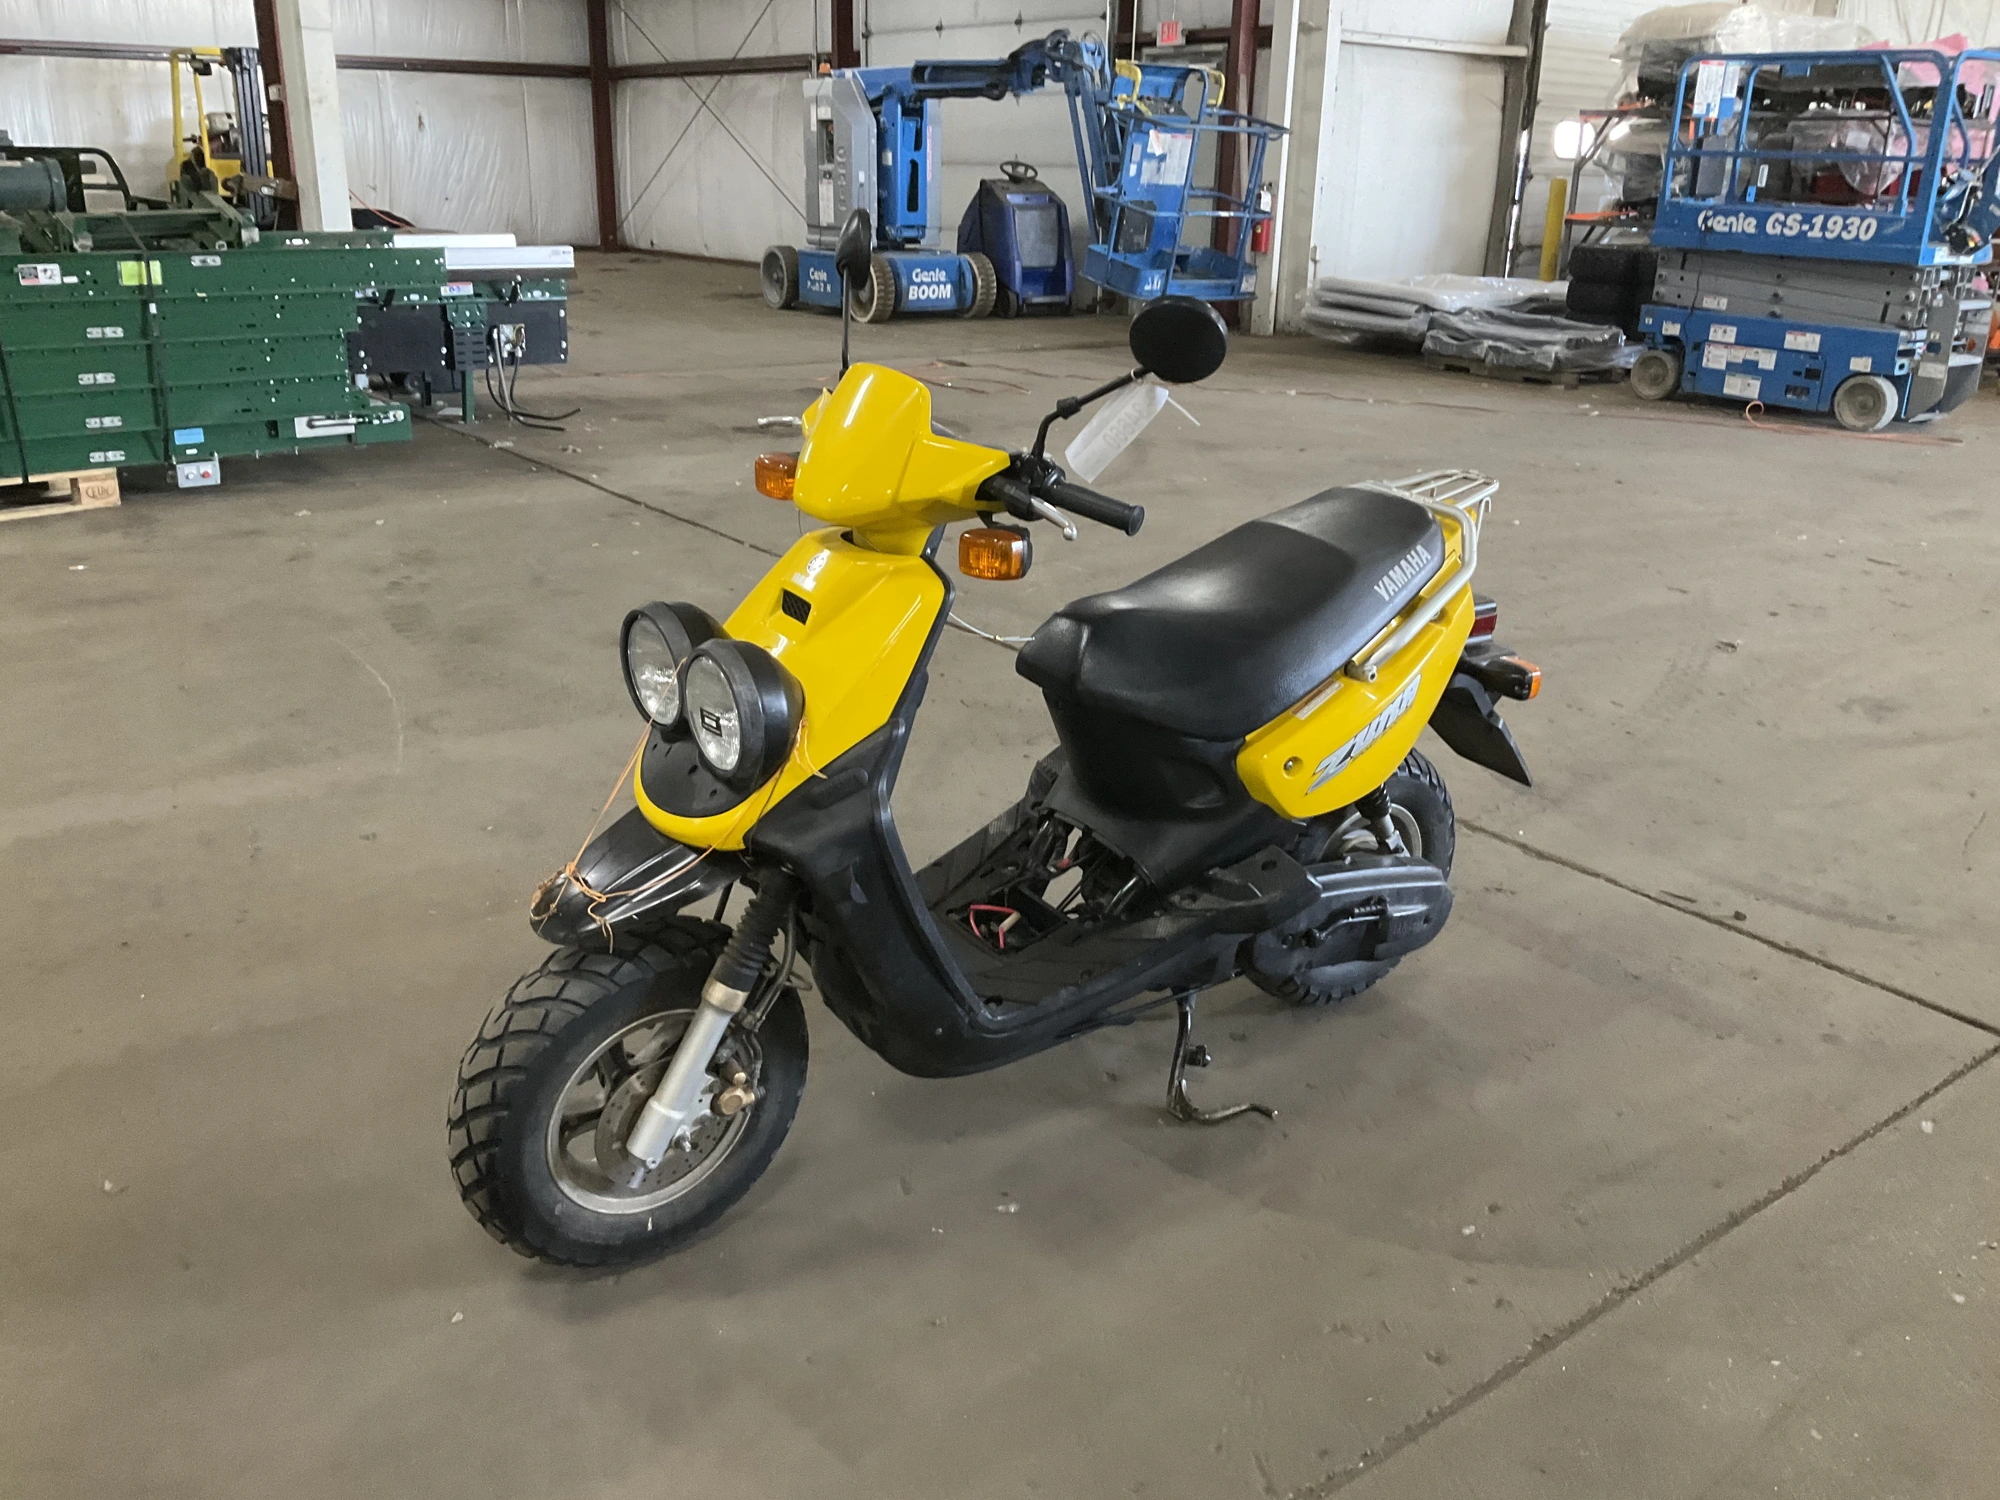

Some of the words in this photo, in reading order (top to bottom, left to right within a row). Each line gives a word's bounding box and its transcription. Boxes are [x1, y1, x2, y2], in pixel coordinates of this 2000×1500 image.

[1697, 209, 1757, 235] Genie
[1765, 211, 1878, 242] GS-1930
[912, 267, 946, 283] Genie
[908, 283, 951, 300] BOOM
[1373, 544, 1431, 601] YAMAHA
